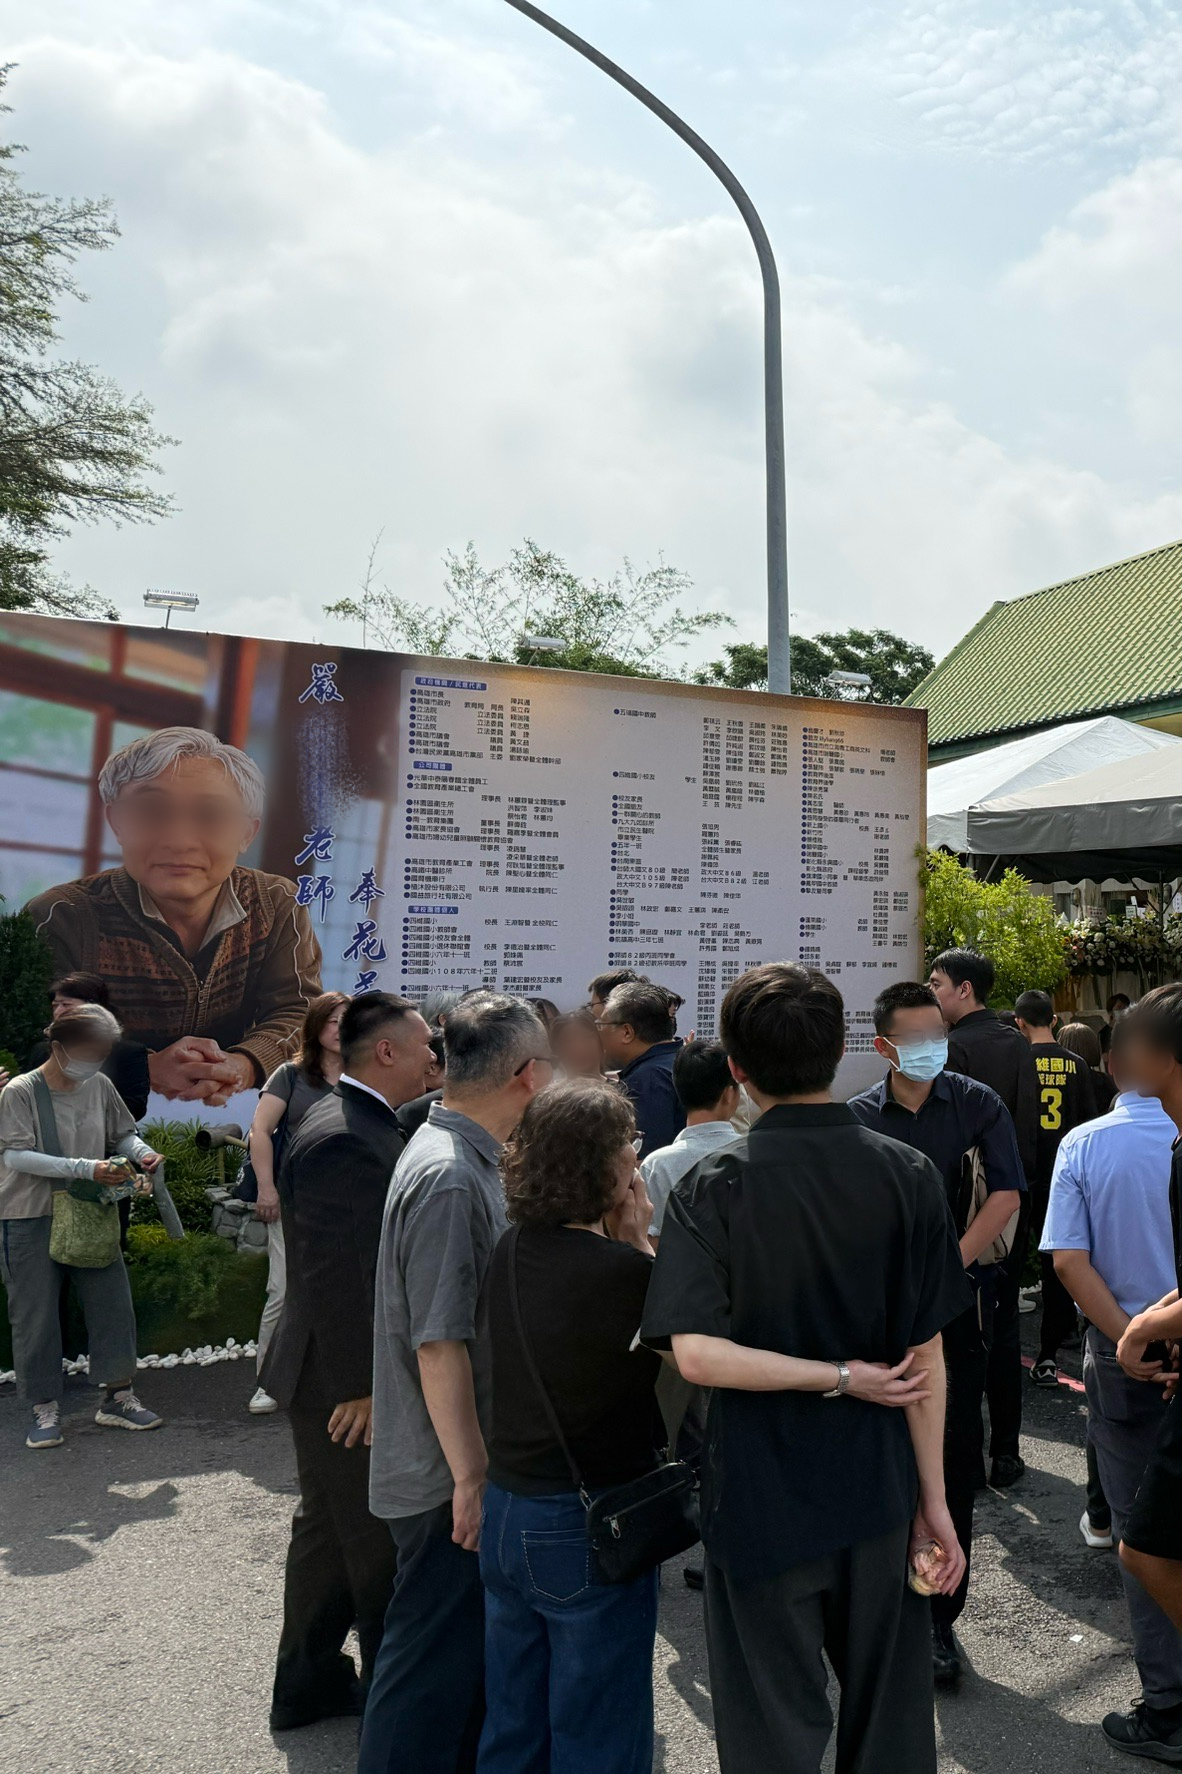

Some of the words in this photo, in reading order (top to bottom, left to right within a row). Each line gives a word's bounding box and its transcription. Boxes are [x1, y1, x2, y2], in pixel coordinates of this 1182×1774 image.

[416, 705, 437, 713] 立法院
[416, 714, 437, 722] 立法院
[416, 722, 436, 730] 立法院
[481, 794, 501, 802] 理事長
[1040, 1088, 1062, 1130] 3
